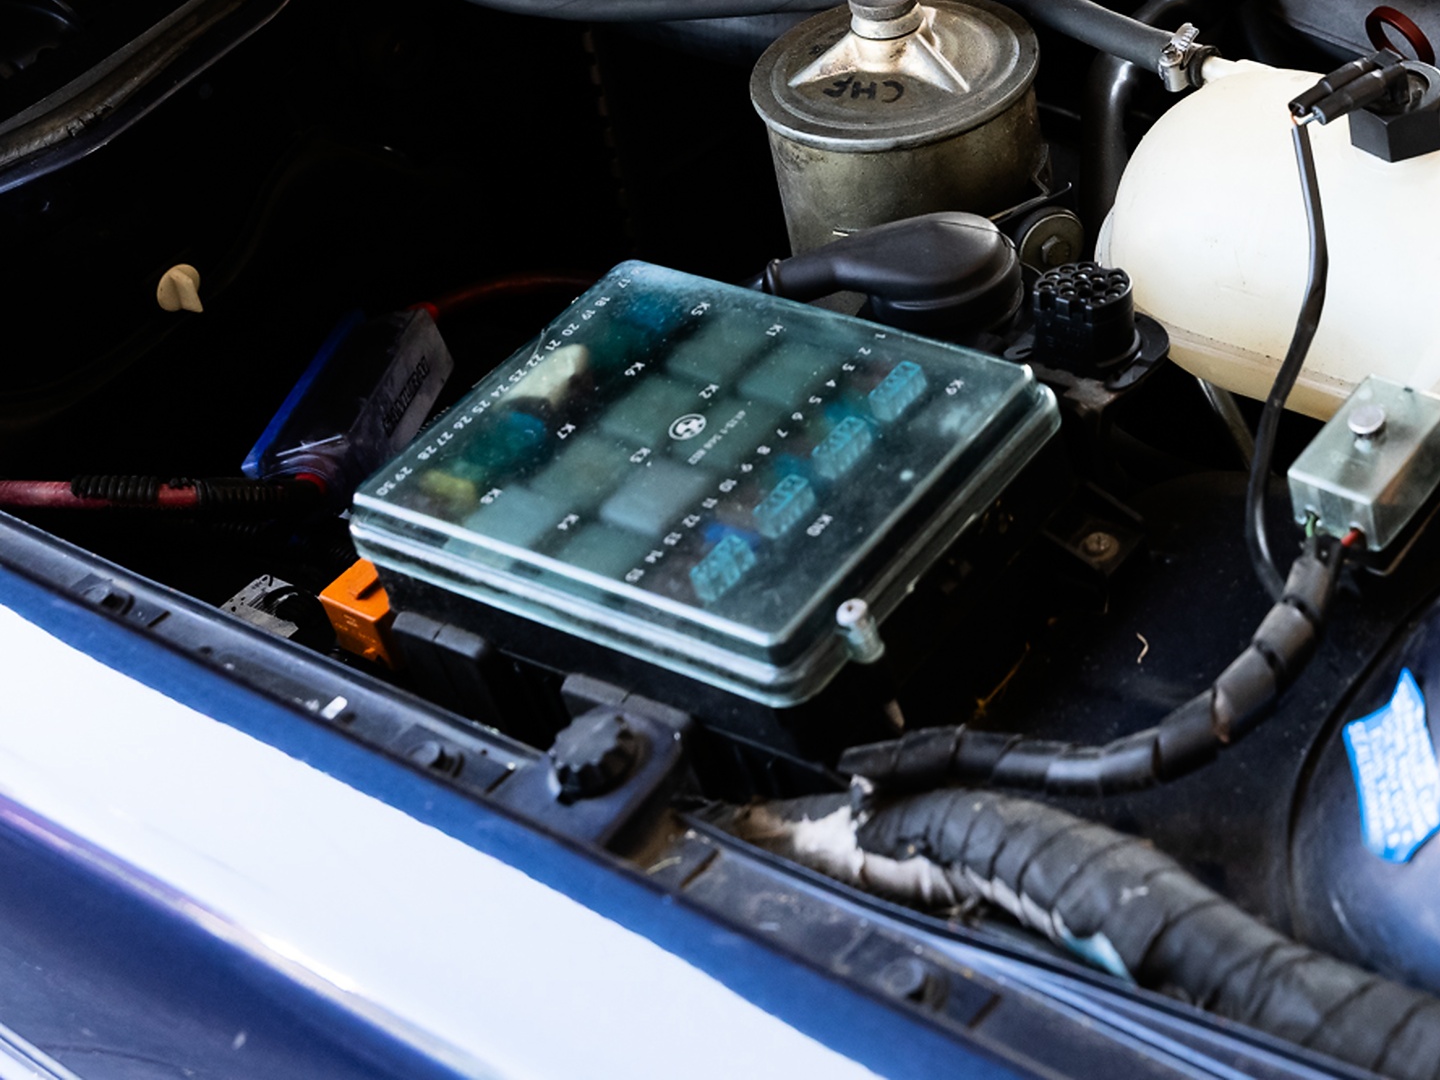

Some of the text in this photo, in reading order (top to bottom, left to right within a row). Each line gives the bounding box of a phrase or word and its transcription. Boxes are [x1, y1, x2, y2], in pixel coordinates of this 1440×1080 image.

[822, 75, 905, 104] CHF
[617, 277, 632, 289] 17
[594, 296, 611, 307] 18
[581, 309, 596, 320] 19
[562, 322, 580, 336] 20
[545, 339, 562, 351] 21
[526, 354, 545, 368] 22
[508, 368, 528, 383] 23
[490, 384, 510, 398] 24
[471, 400, 491, 414] 25
[480, 302, 711, 504] K5 K6 K7 K8
[453, 415, 473, 430] 26
[556, 324, 784, 530] K1 K2 K3 K4
[436, 431, 454, 446] 27
[417, 445, 438, 460] 28
[624, 332, 886, 583] 1 2 3 4 5 6 7 8 9 10 11 12 13 14 15
[806, 378, 965, 537] K9 K10
[394, 466, 413, 481] 29
[376, 480, 396, 496] 30
